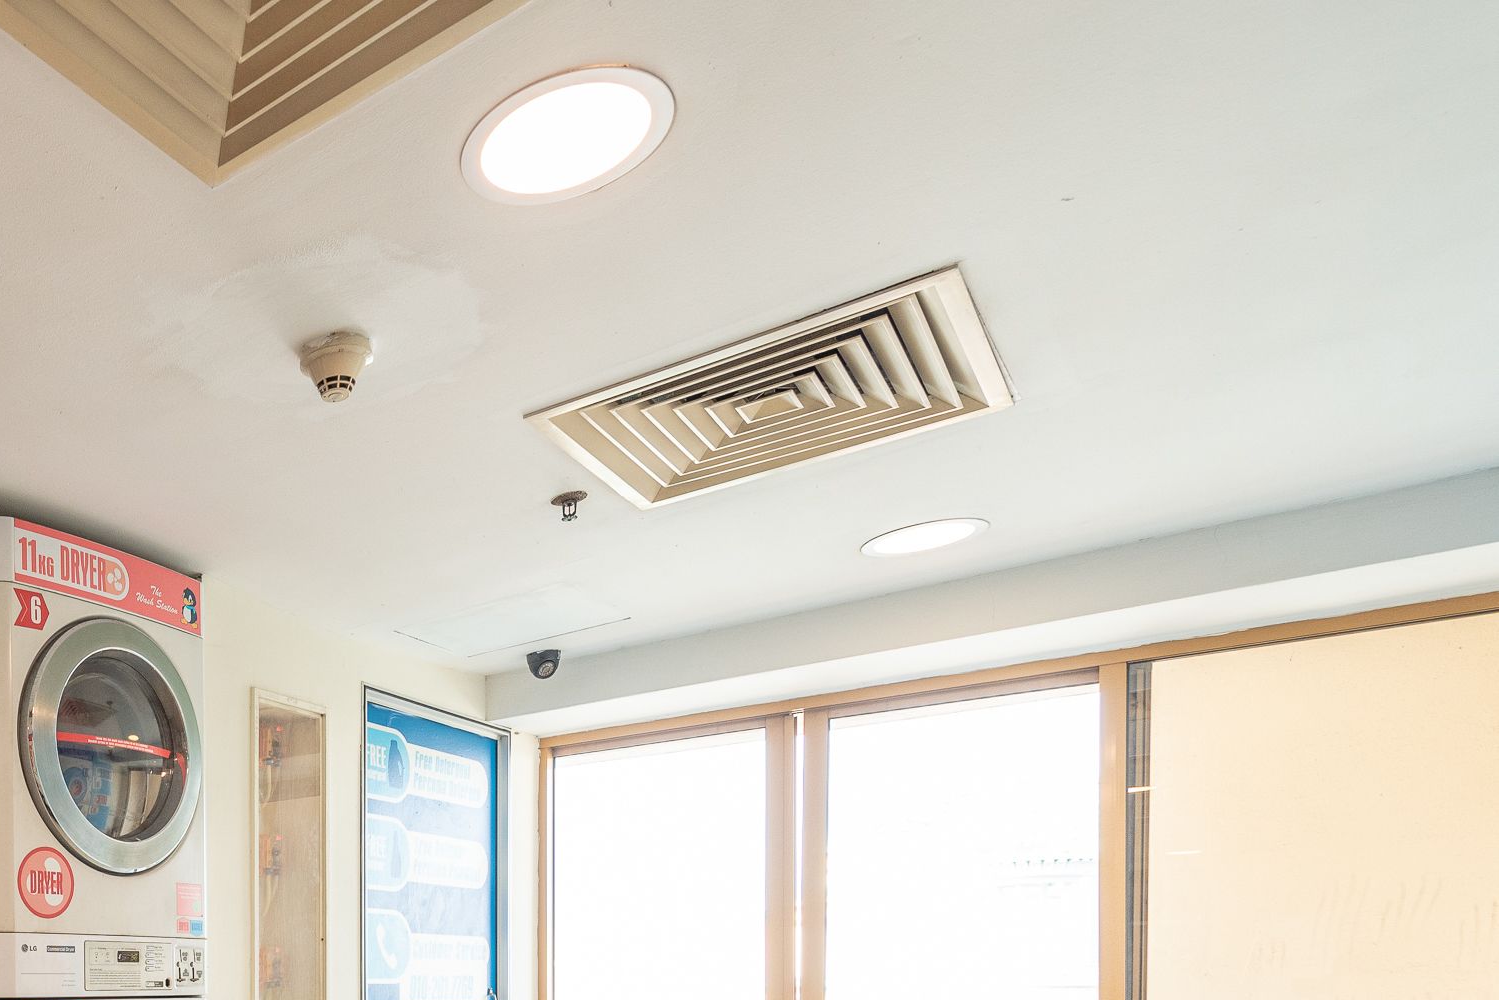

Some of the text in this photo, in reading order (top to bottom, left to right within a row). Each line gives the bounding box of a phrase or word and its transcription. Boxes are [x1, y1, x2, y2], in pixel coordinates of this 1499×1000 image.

[18, 536, 106, 593] 11KG DRYER
[135, 591, 179, 616] Wash Station
[150, 585, 163, 598] The
[30, 595, 42, 625] 6
[415, 751, 433, 770] Free
[29, 869, 63, 895] DRYER
